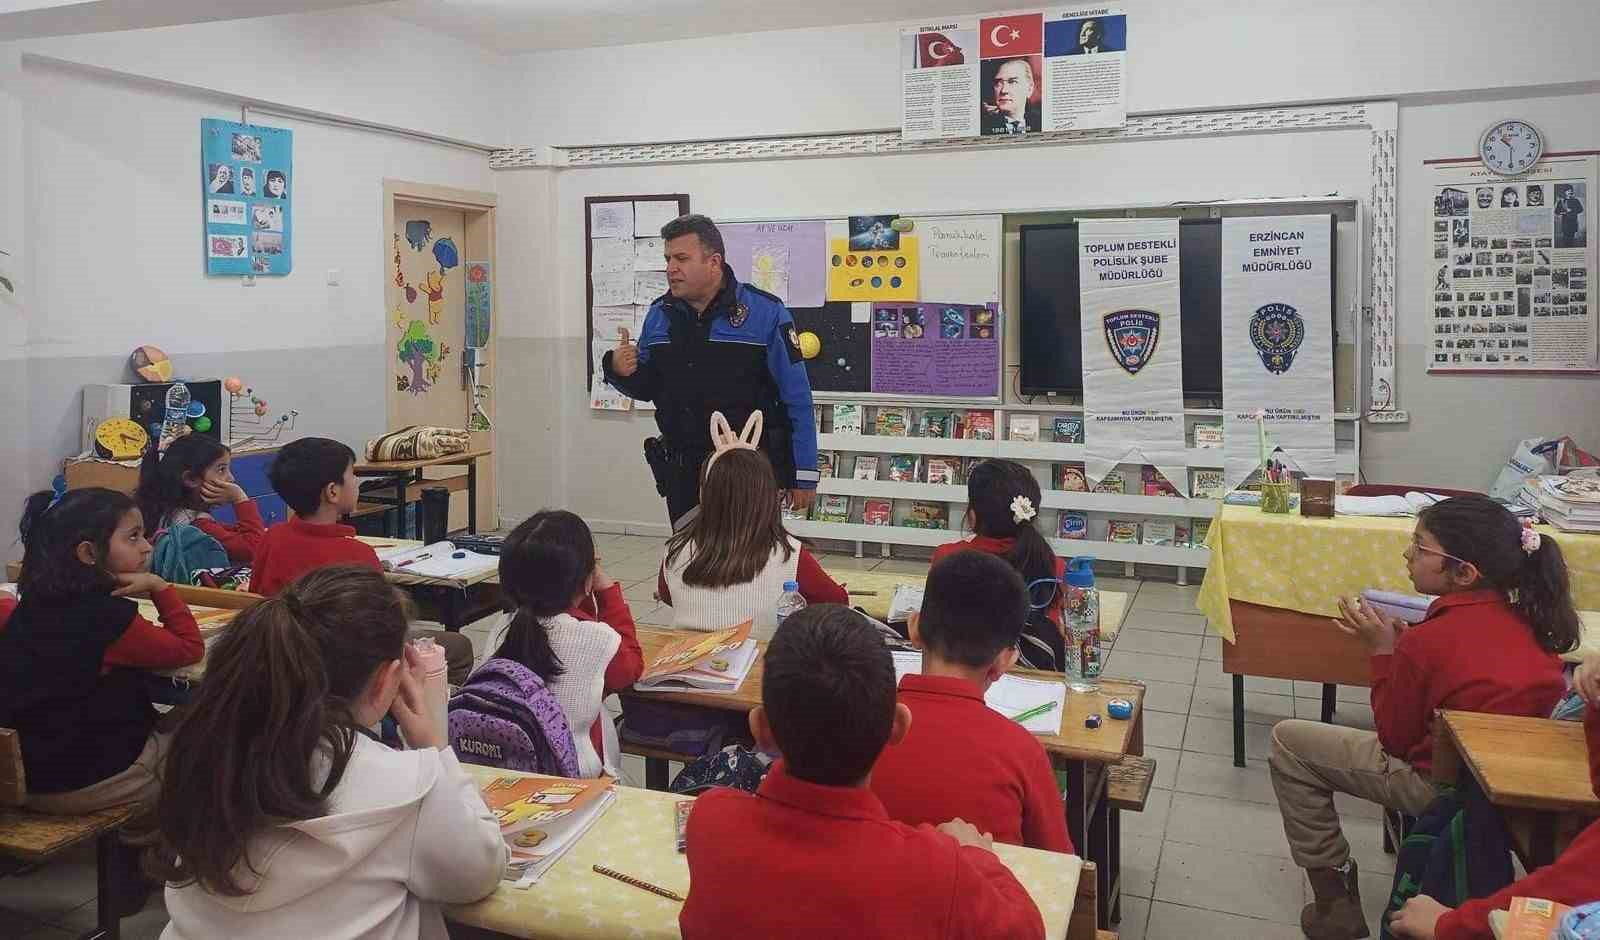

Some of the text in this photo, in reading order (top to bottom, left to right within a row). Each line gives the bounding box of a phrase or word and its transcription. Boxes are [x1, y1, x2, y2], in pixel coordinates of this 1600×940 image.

[1249, 230, 1305, 242] ERZİNCAN
[1083, 238, 1177, 253] TOPLUM DESTEKLİ
[1253, 245, 1302, 257] EMNİYET
[1093, 254, 1169, 267] POLİSLİK ŞUBE
[1242, 257, 1312, 273] MÜDÜRLÜĞÜ
[1099, 268, 1163, 281] MÜDÜRLÜĞÜ
[1260, 304, 1293, 316] POLİS
[459, 737, 503, 761] KUROMI
